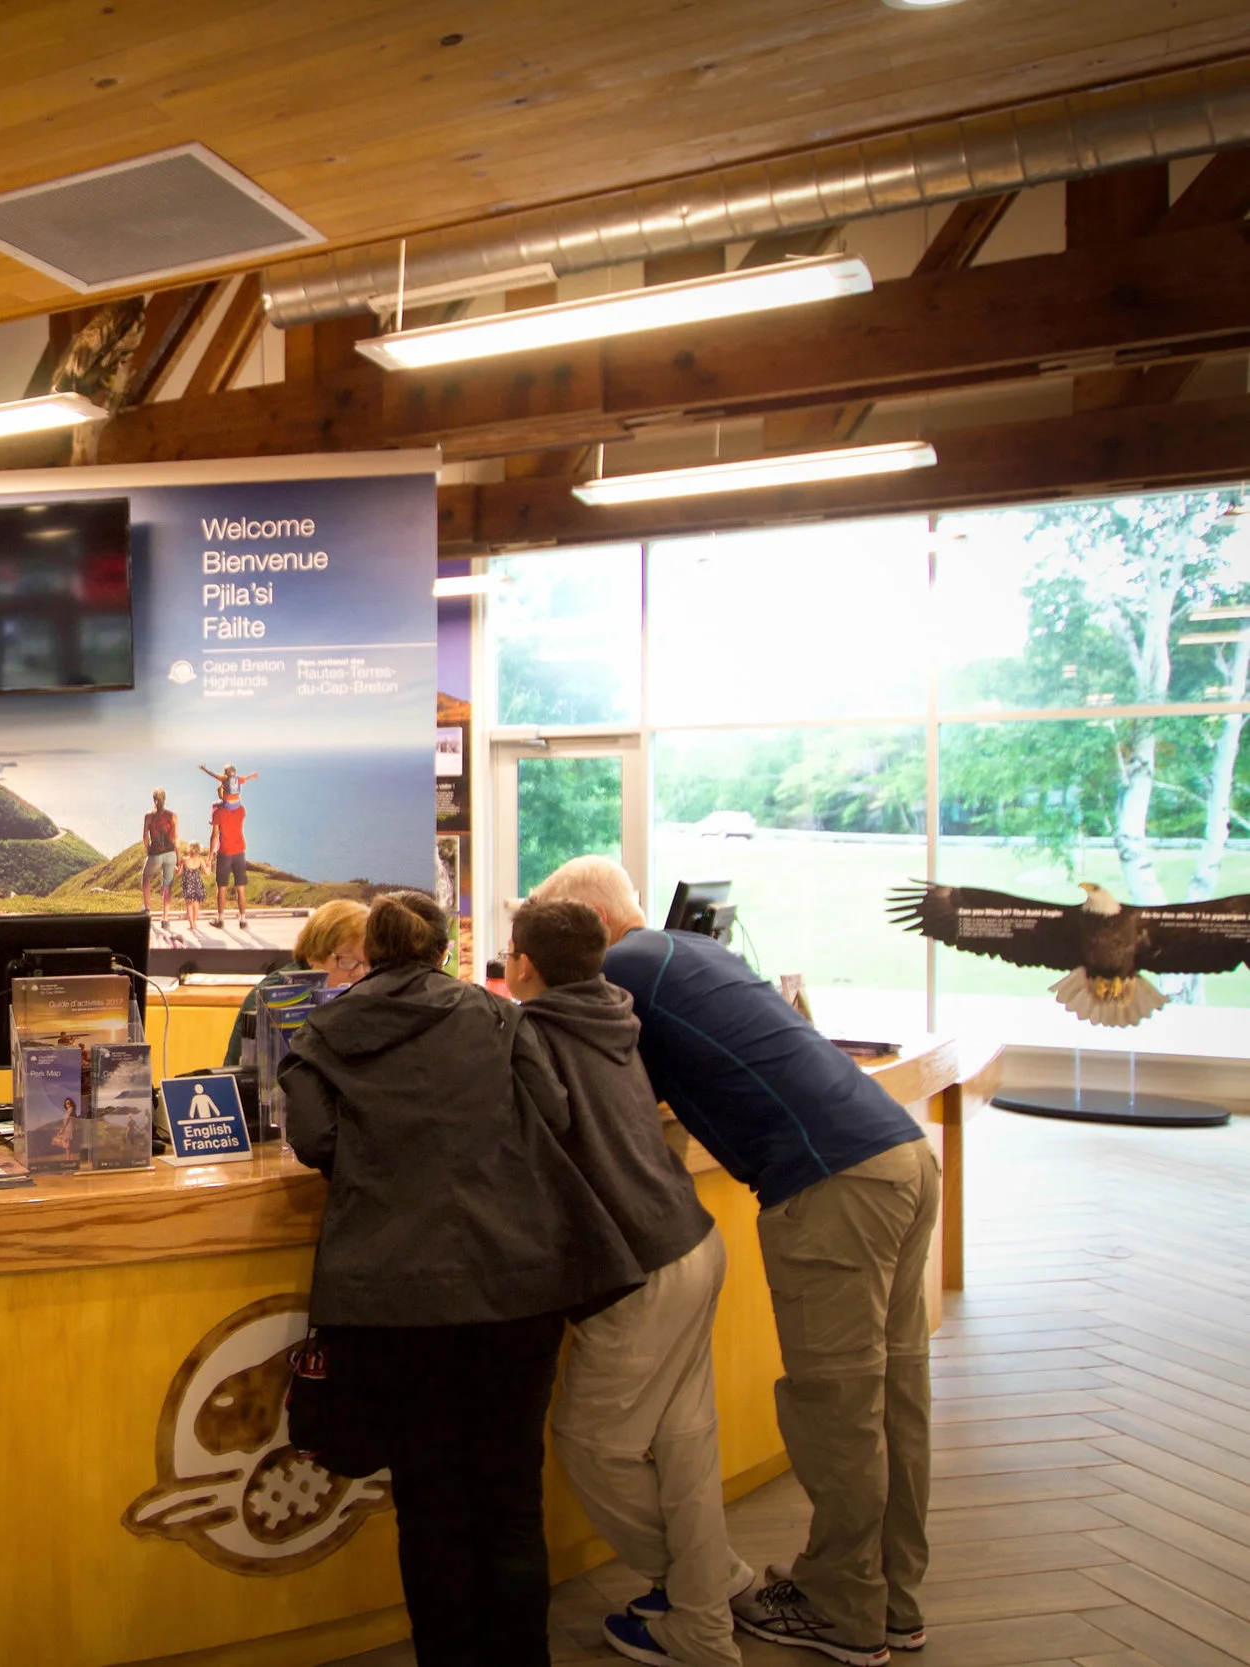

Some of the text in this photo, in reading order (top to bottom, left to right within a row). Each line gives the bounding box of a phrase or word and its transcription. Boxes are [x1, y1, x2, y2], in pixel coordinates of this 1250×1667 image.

[202, 517, 316, 541] Welcome
[203, 550, 329, 574] Bienvenue
[203, 582, 273, 611] Pjila'si
[203, 616, 266, 639] Fàilte
[203, 658, 285, 674] Cape Breton
[317, 658, 349, 666] national
[203, 674, 268, 690] Highlands
[297, 680, 398, 696] du-Cap-Breton
[236, 689, 254, 697] Park
[49, 1000, 69, 1008] Guide
[106, 998, 124, 1007] 2017
[30, 1069, 61, 1078] Park Map
[183, 1123, 232, 1139] English
[183, 1136, 239, 1150] Français
